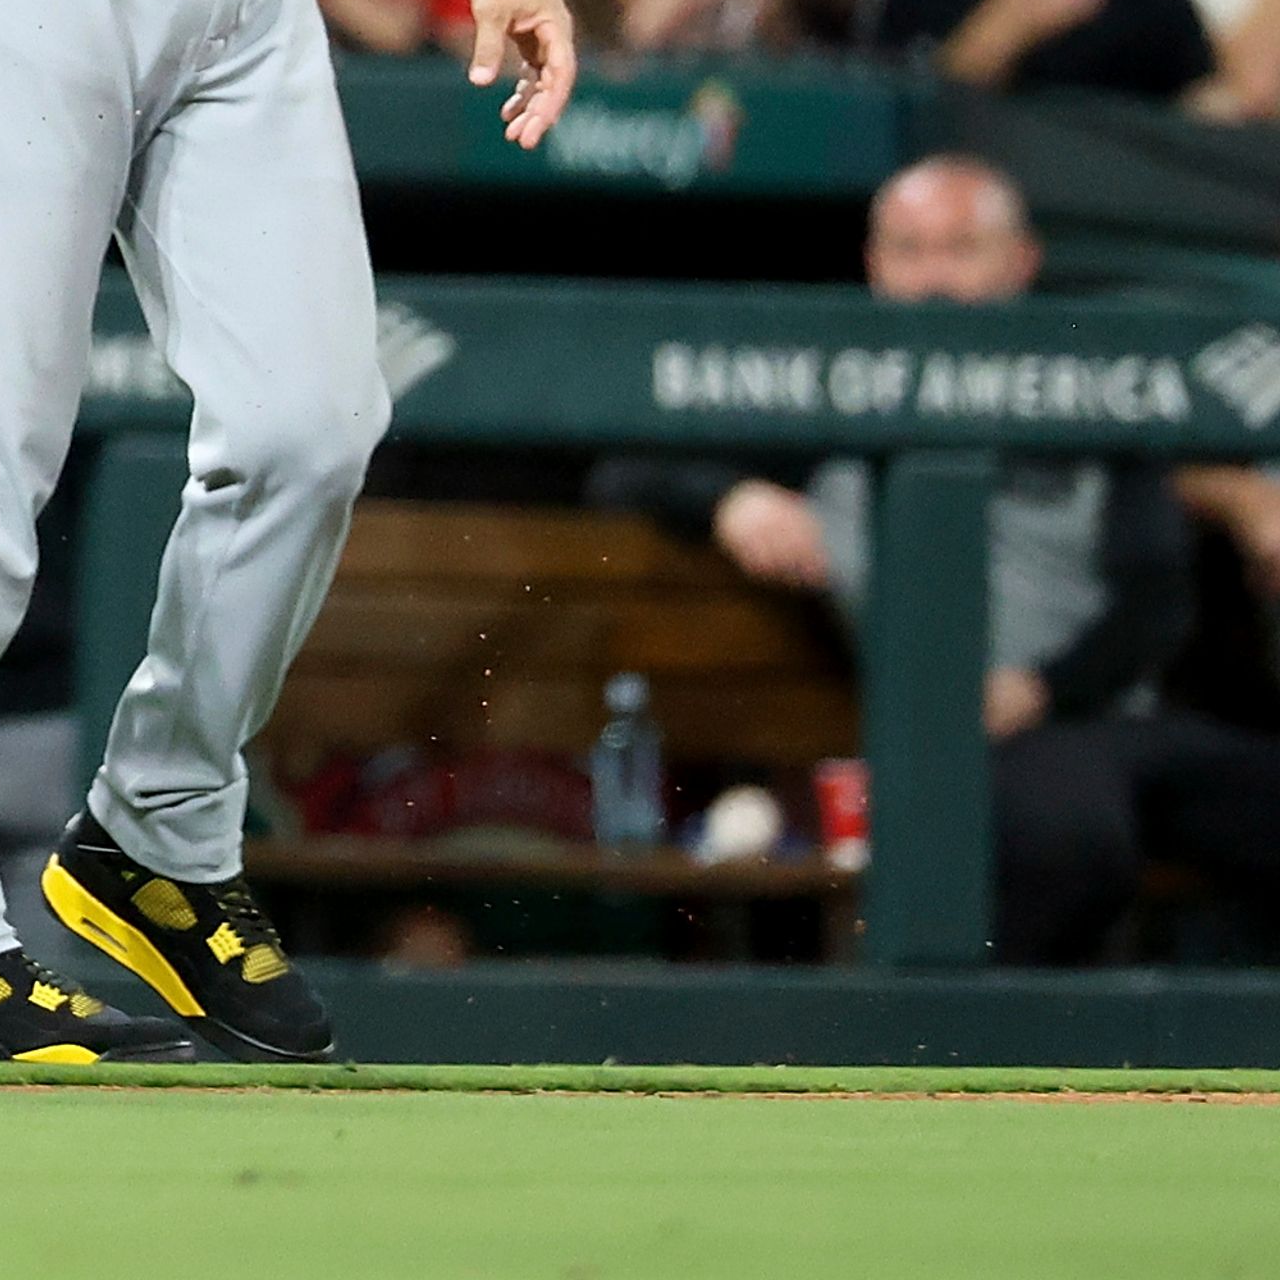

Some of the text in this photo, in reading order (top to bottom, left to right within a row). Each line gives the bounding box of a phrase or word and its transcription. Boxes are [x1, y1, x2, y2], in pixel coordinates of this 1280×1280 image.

[652, 340, 1191, 422] BANK OF AMERICA
